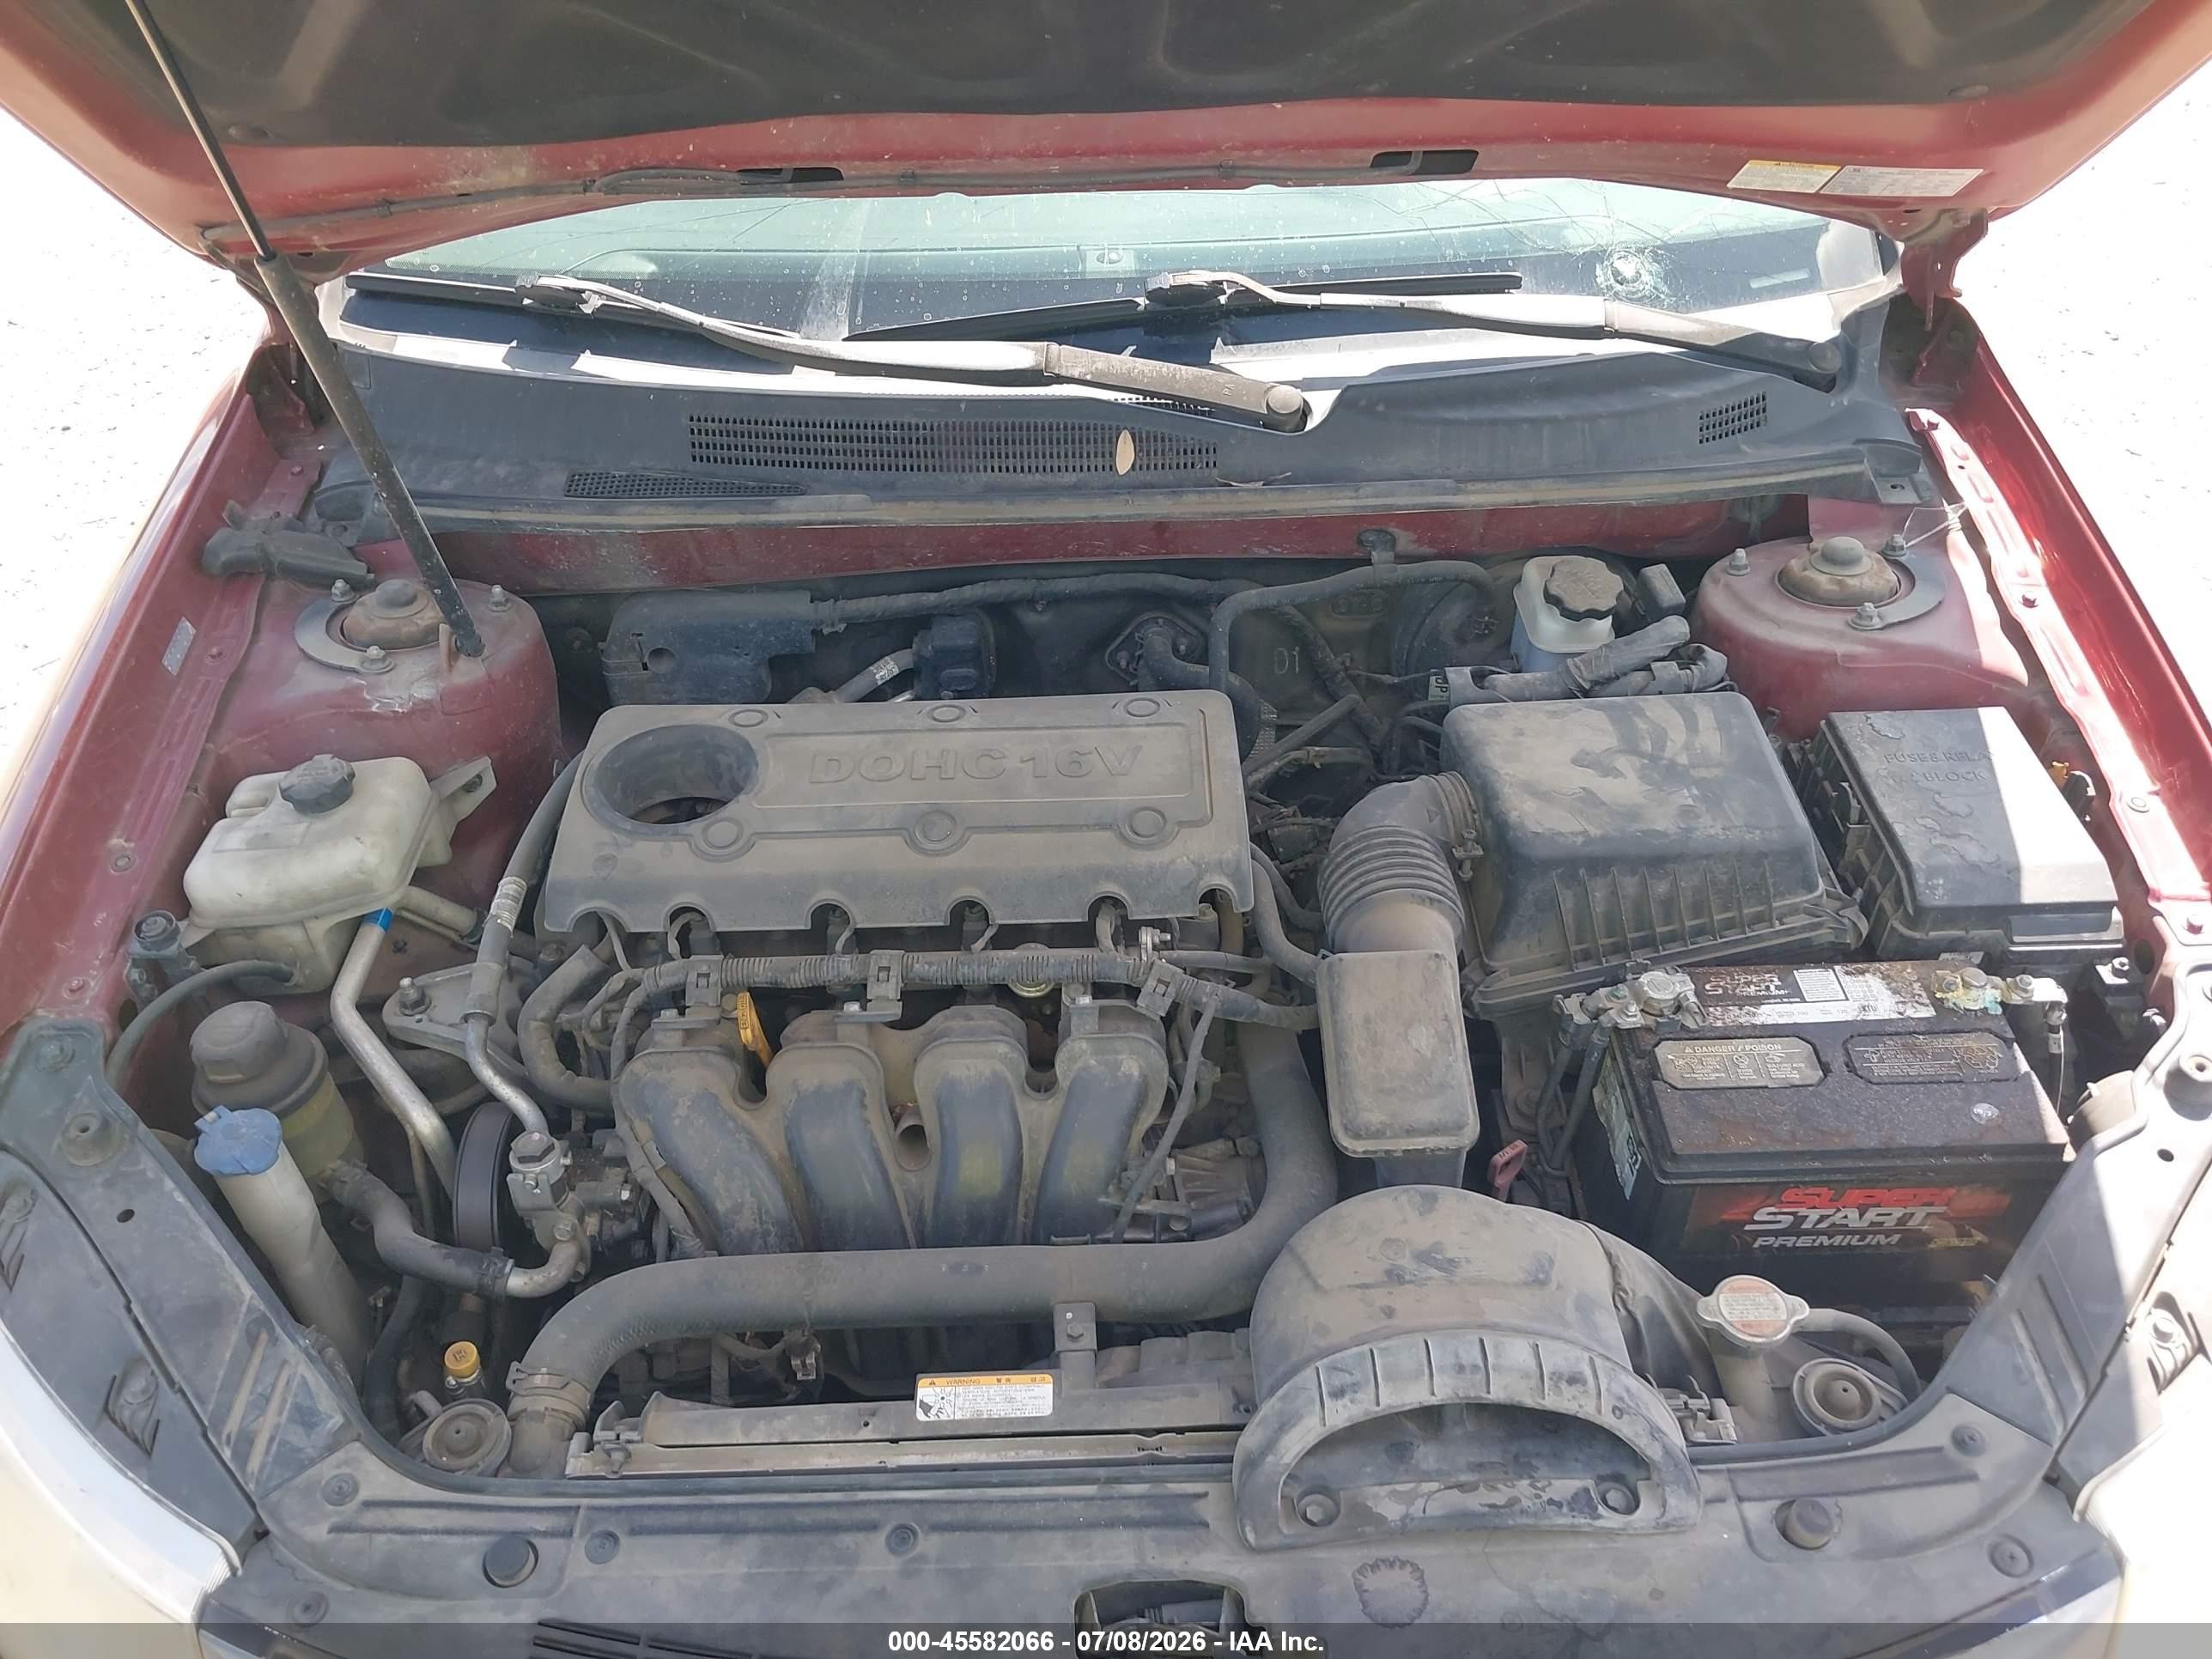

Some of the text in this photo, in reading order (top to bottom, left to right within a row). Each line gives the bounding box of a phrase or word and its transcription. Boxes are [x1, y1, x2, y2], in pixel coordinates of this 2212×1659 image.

[809, 744, 1143, 784] DOHC 16V
[1923, 771, 1988, 782] BLOCK
[1694, 1044, 1736, 1053] DANGER
[1745, 1042, 1783, 1052] POISON
[1775, 1187, 1956, 1209] SUPER
[1744, 1206, 1948, 1231] START
[1752, 1234, 1902, 1249] PREMIUM
[945, 1377, 981, 1386] WARNING
